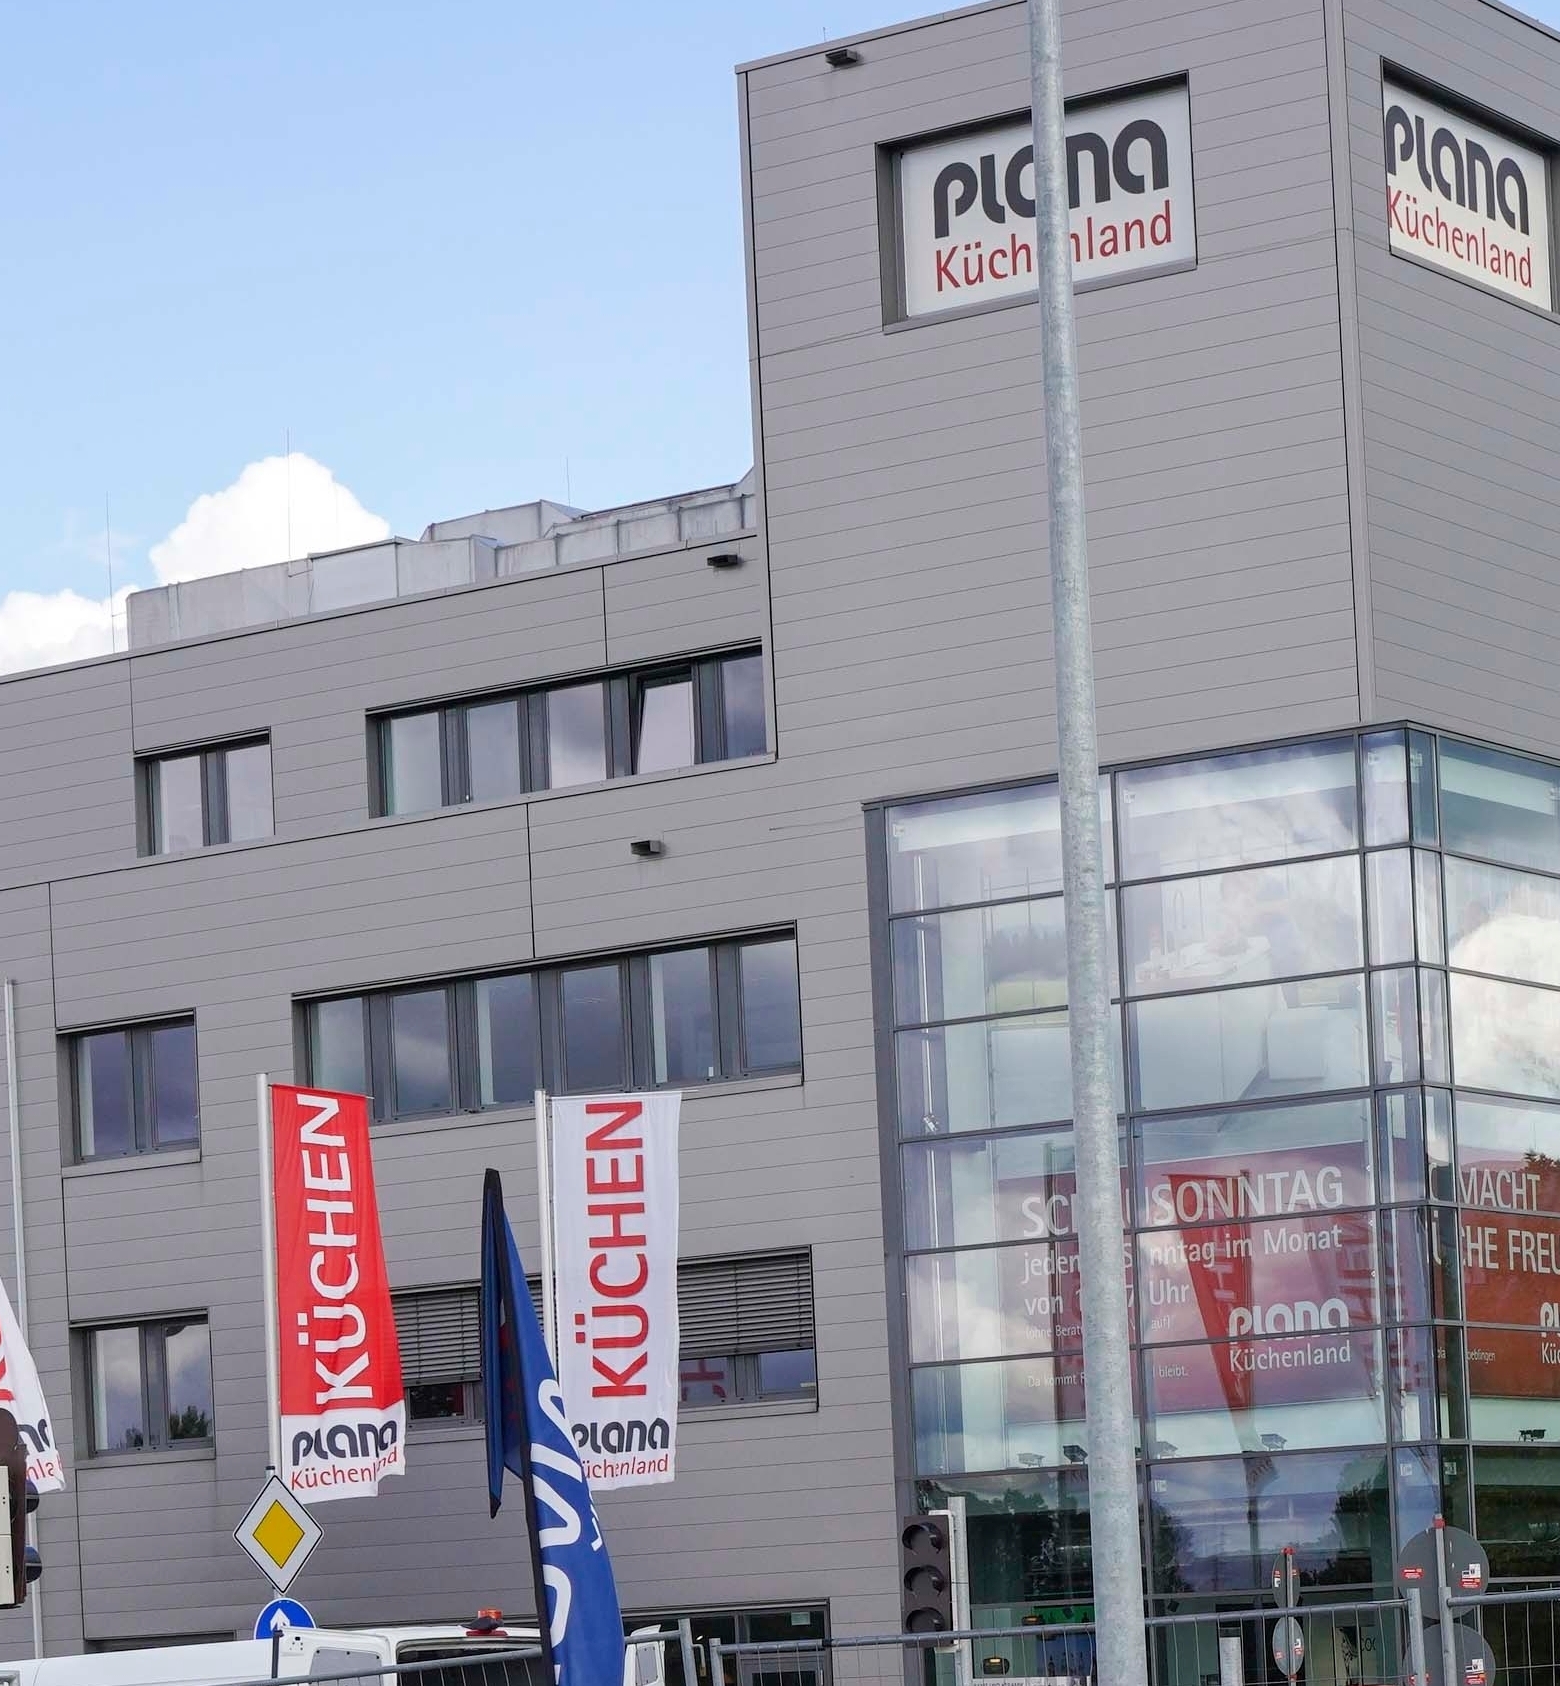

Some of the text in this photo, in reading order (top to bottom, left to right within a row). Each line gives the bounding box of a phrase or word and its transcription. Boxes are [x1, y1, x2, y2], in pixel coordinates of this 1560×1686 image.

[1385, 105, 1530, 236] plana
[935, 199, 1172, 292] Küchland
[1386, 185, 1532, 288] Küchenland
[1458, 1167, 1540, 1211] MACHT
[296, 1093, 373, 1404] KÜCHEN
[574, 1100, 649, 1398] KÜCHEN
[1022, 1225, 1343, 1284] jeden Snntag im Monat
[1024, 1294, 1064, 1316] von
[1149, 1280, 1190, 1306] Uhr
[1055, 1324, 1083, 1338] Berat
[1229, 1299, 1350, 1344] plana
[1230, 1341, 1351, 1373] Küchenland
[571, 1417, 669, 1454] plana
[290, 1446, 398, 1491] Küchenlnd
